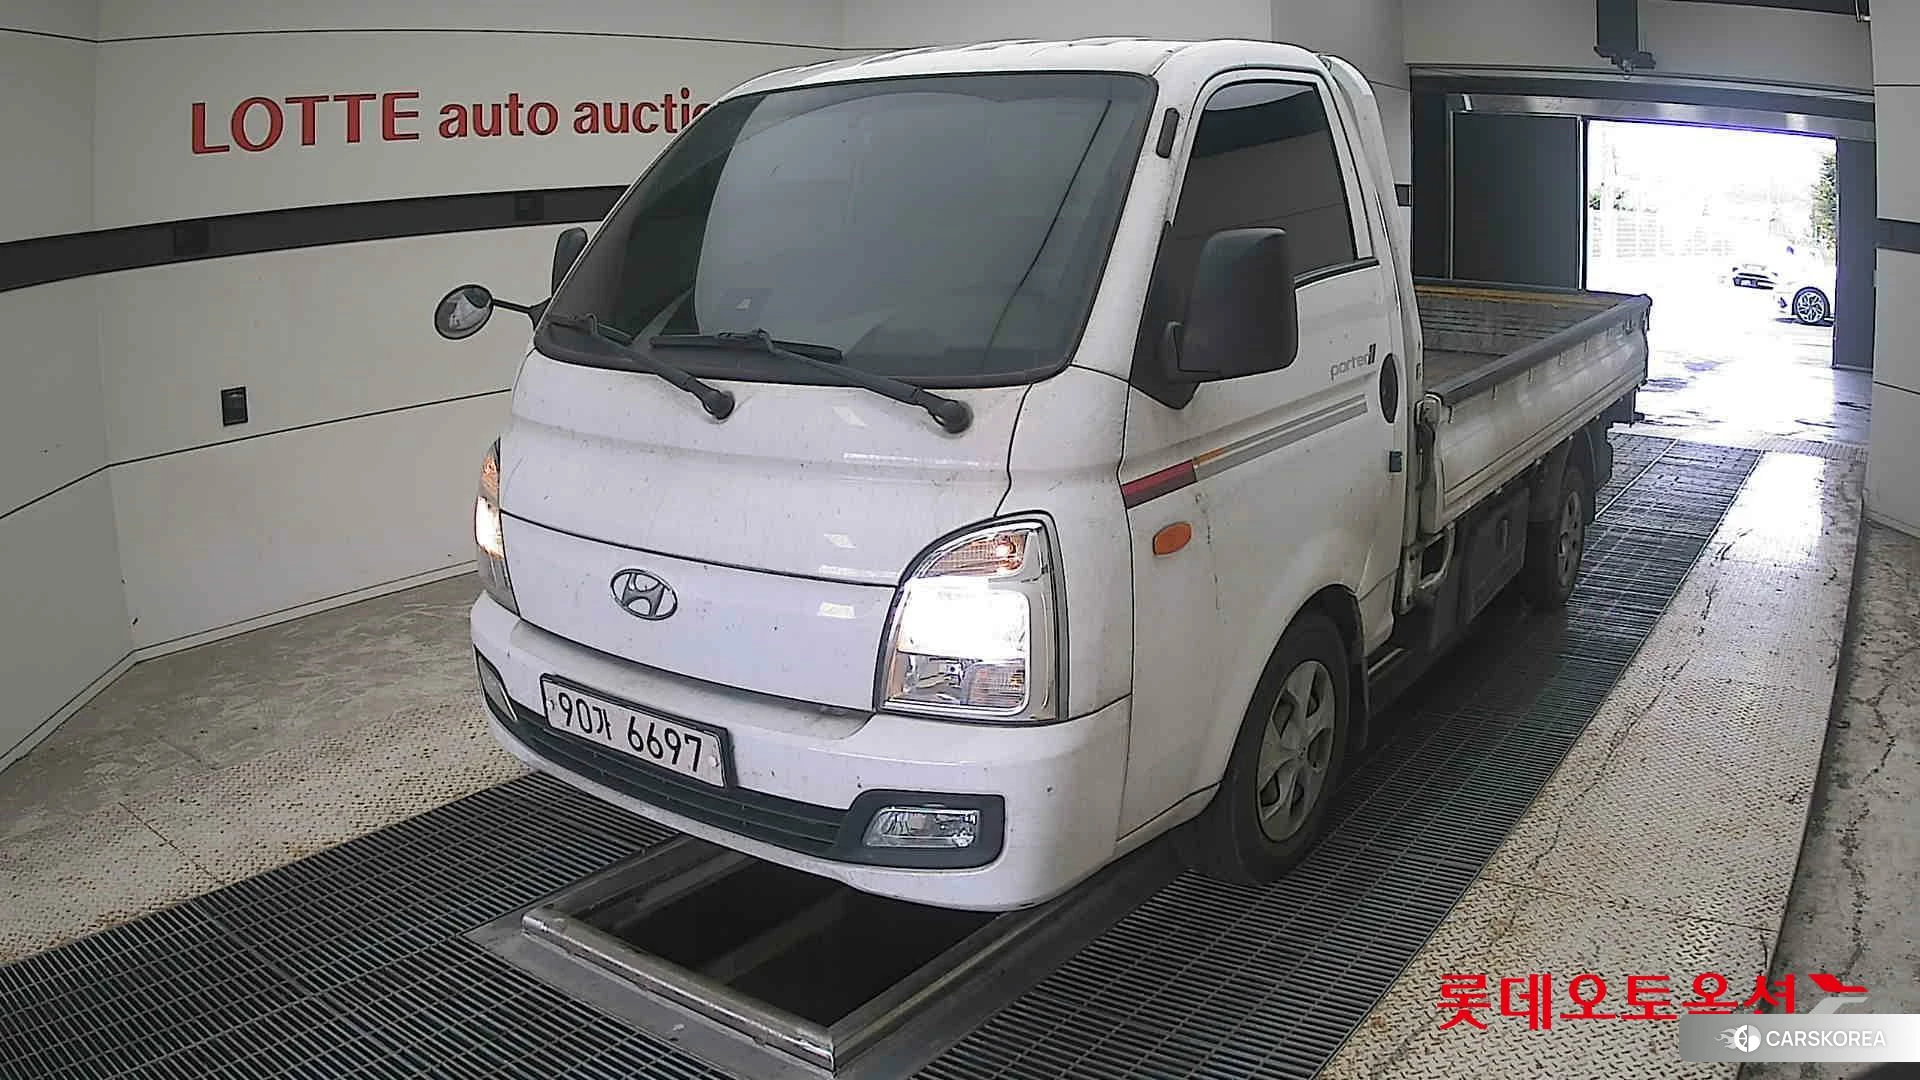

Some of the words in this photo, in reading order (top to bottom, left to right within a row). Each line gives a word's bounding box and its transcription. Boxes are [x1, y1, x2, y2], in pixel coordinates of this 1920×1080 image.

[191, 91, 419, 155] LOTTE
[438, 93, 559, 138] auto
[572, 87, 711, 134] aucti
[558, 692, 612, 741] 90가
[627, 715, 703, 773] 6697
